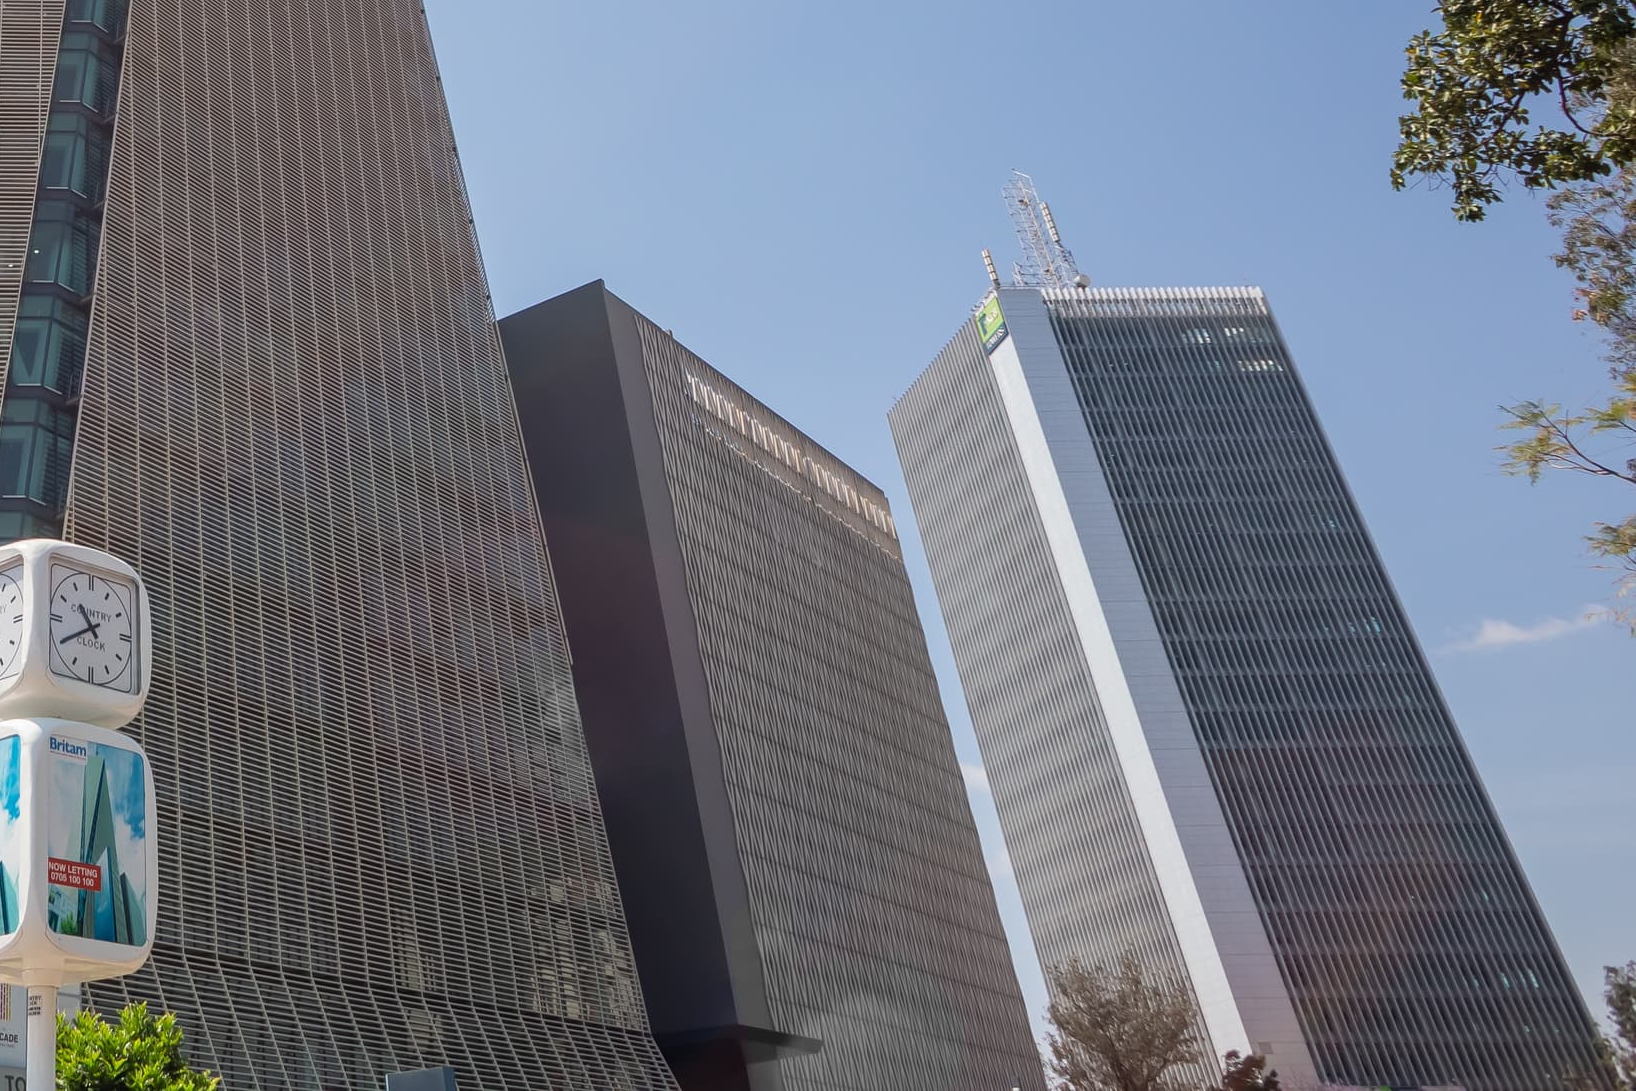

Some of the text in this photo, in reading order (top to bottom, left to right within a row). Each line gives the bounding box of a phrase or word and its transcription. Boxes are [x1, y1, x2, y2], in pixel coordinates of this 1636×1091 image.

[76, 637, 105, 652] CLOCK
[49, 737, 86, 757] Britam
[49, 862, 98, 878] NOW LETTING
[50, 872, 95, 887] 0705 100 100
[4, 1075, 27, 1091] TO
